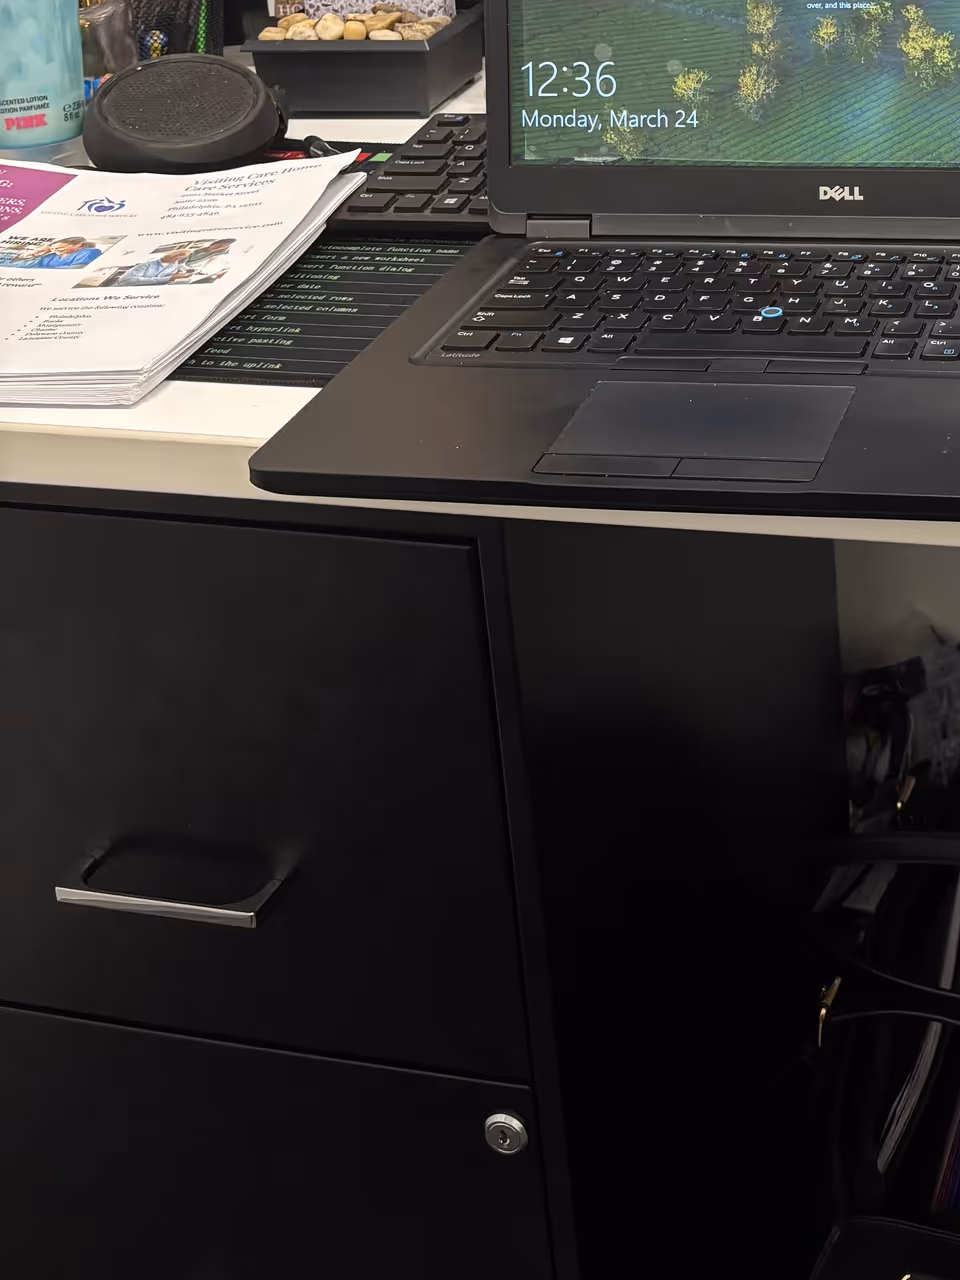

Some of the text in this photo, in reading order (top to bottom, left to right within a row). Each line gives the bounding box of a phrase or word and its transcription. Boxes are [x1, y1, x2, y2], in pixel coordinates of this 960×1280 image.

[806, 1, 852, 10] over, and this
[519, 60, 617, 98] 12:36
[25, 95, 49, 104] LOTION
[4, 113, 49, 131] PINK
[520, 108, 699, 132] Monday, March 24
[184, 178, 277, 192] Care Services
[193, 176, 245, 186] Visiting
[246, 169, 279, 181] Care
[818, 185, 864, 202] DELL
[385, 246, 432, 254] function
[374, 255, 426, 264] worksheet
